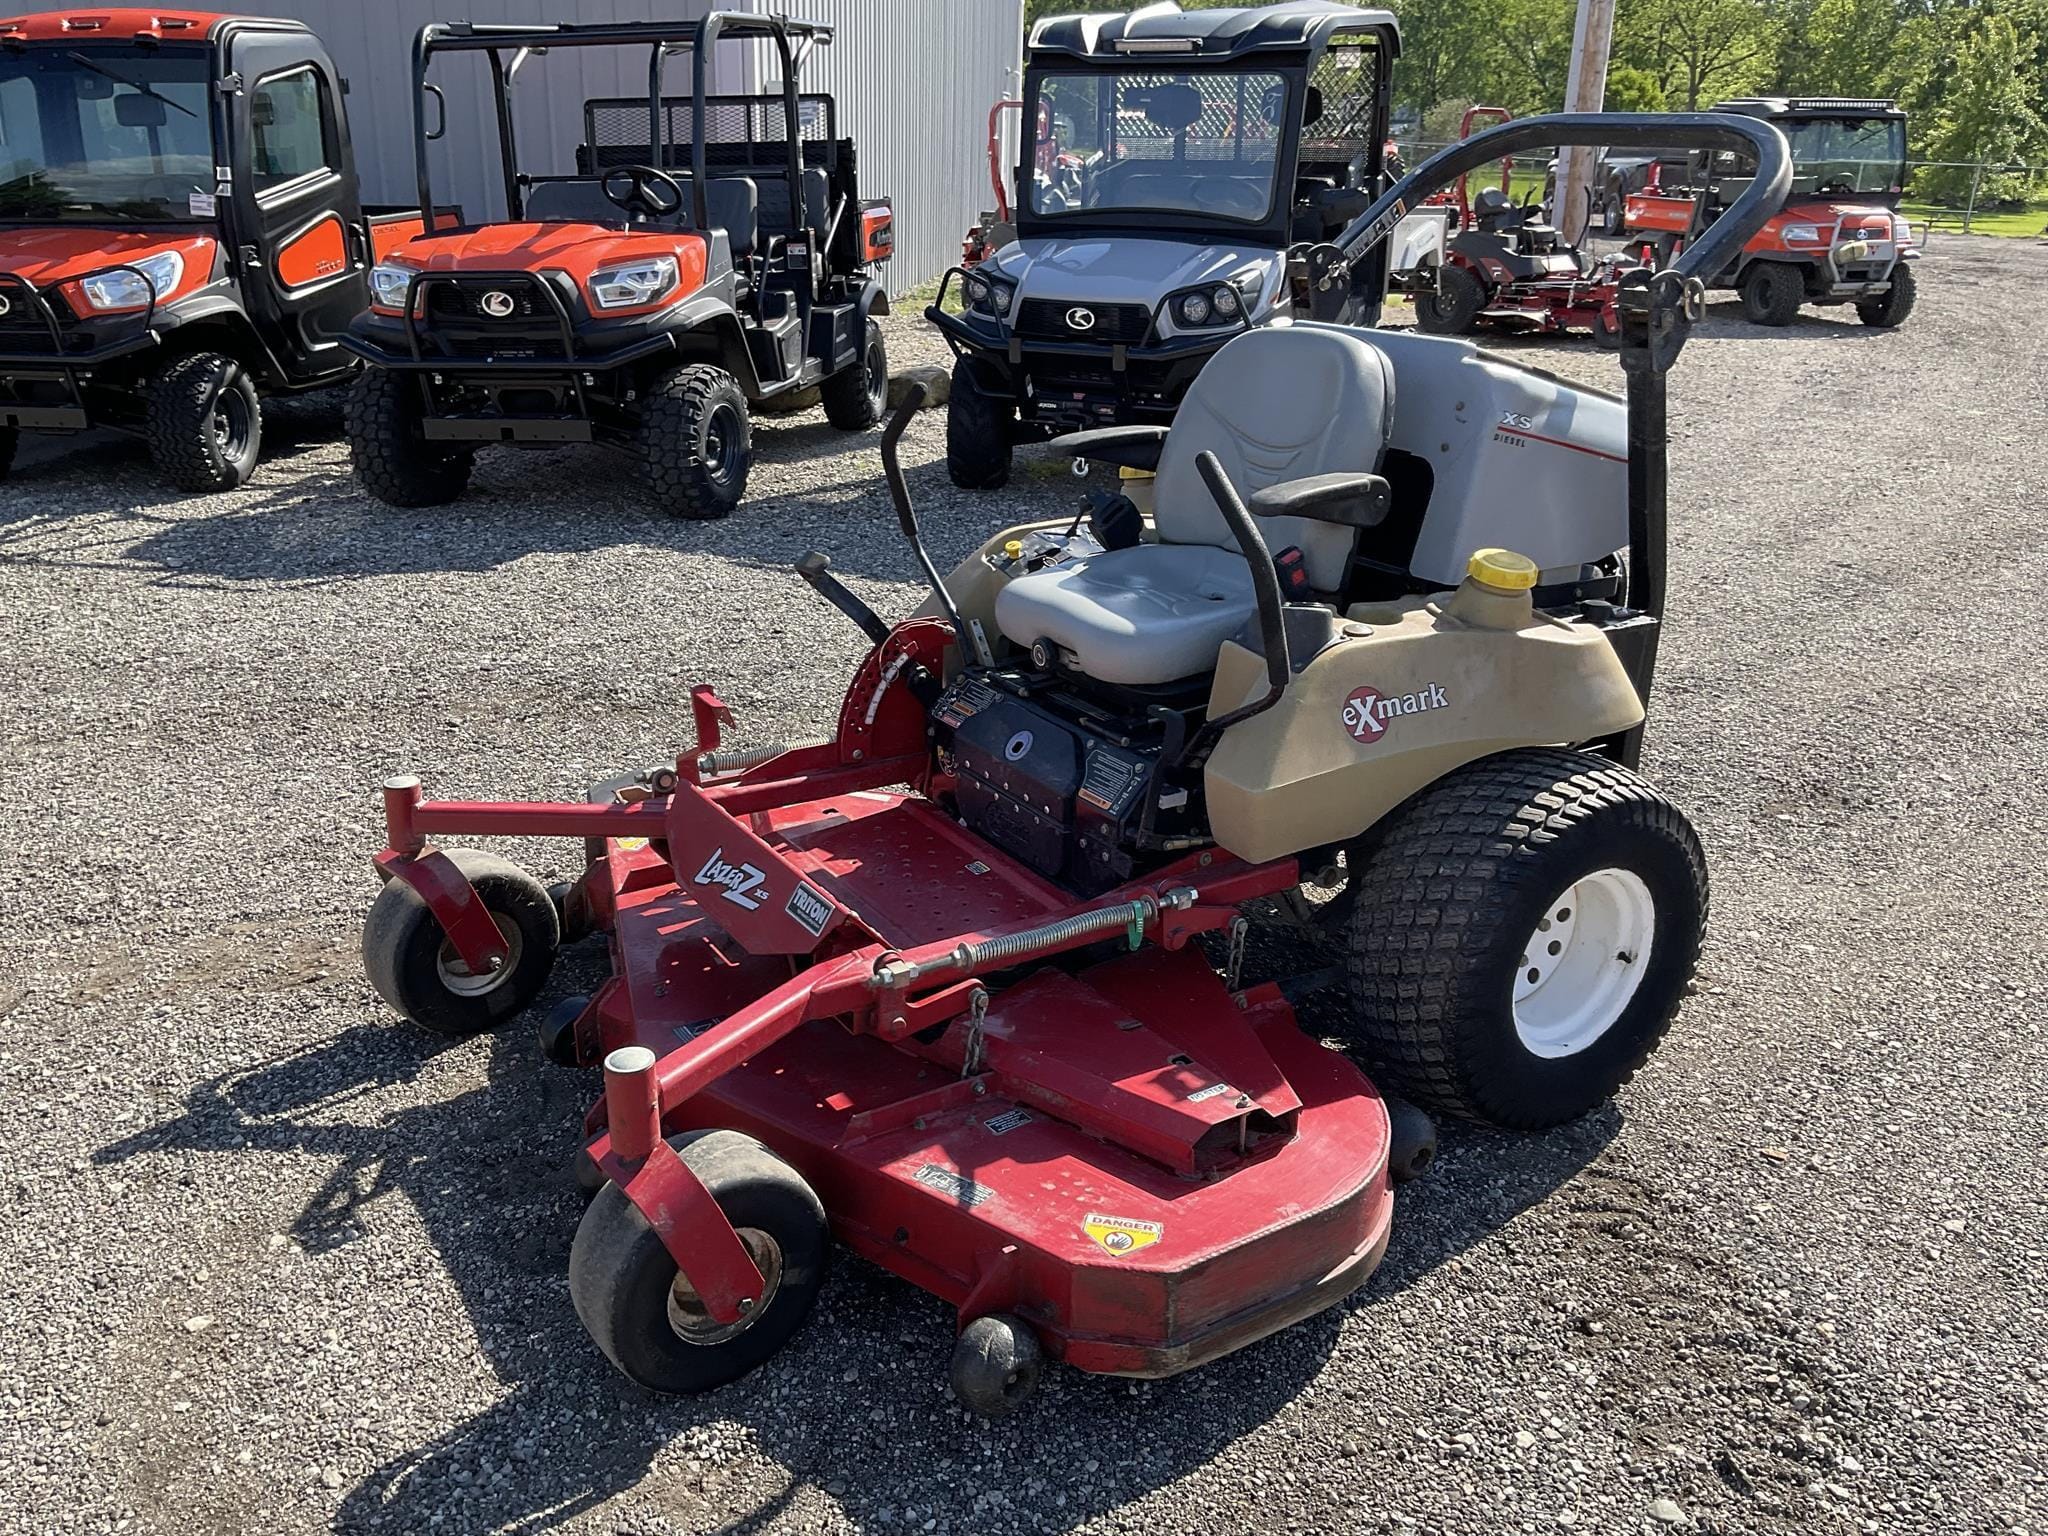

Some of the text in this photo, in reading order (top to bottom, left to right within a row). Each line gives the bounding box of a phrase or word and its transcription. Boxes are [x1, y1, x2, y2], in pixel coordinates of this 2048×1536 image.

[1502, 411, 1532, 429] XS
[1493, 433, 1526, 447] DIESEL
[1342, 682, 1449, 736] eXmark
[754, 888, 770, 900] XS
[793, 889, 829, 925] TRITON
[1092, 1216, 1155, 1232] DANGER
